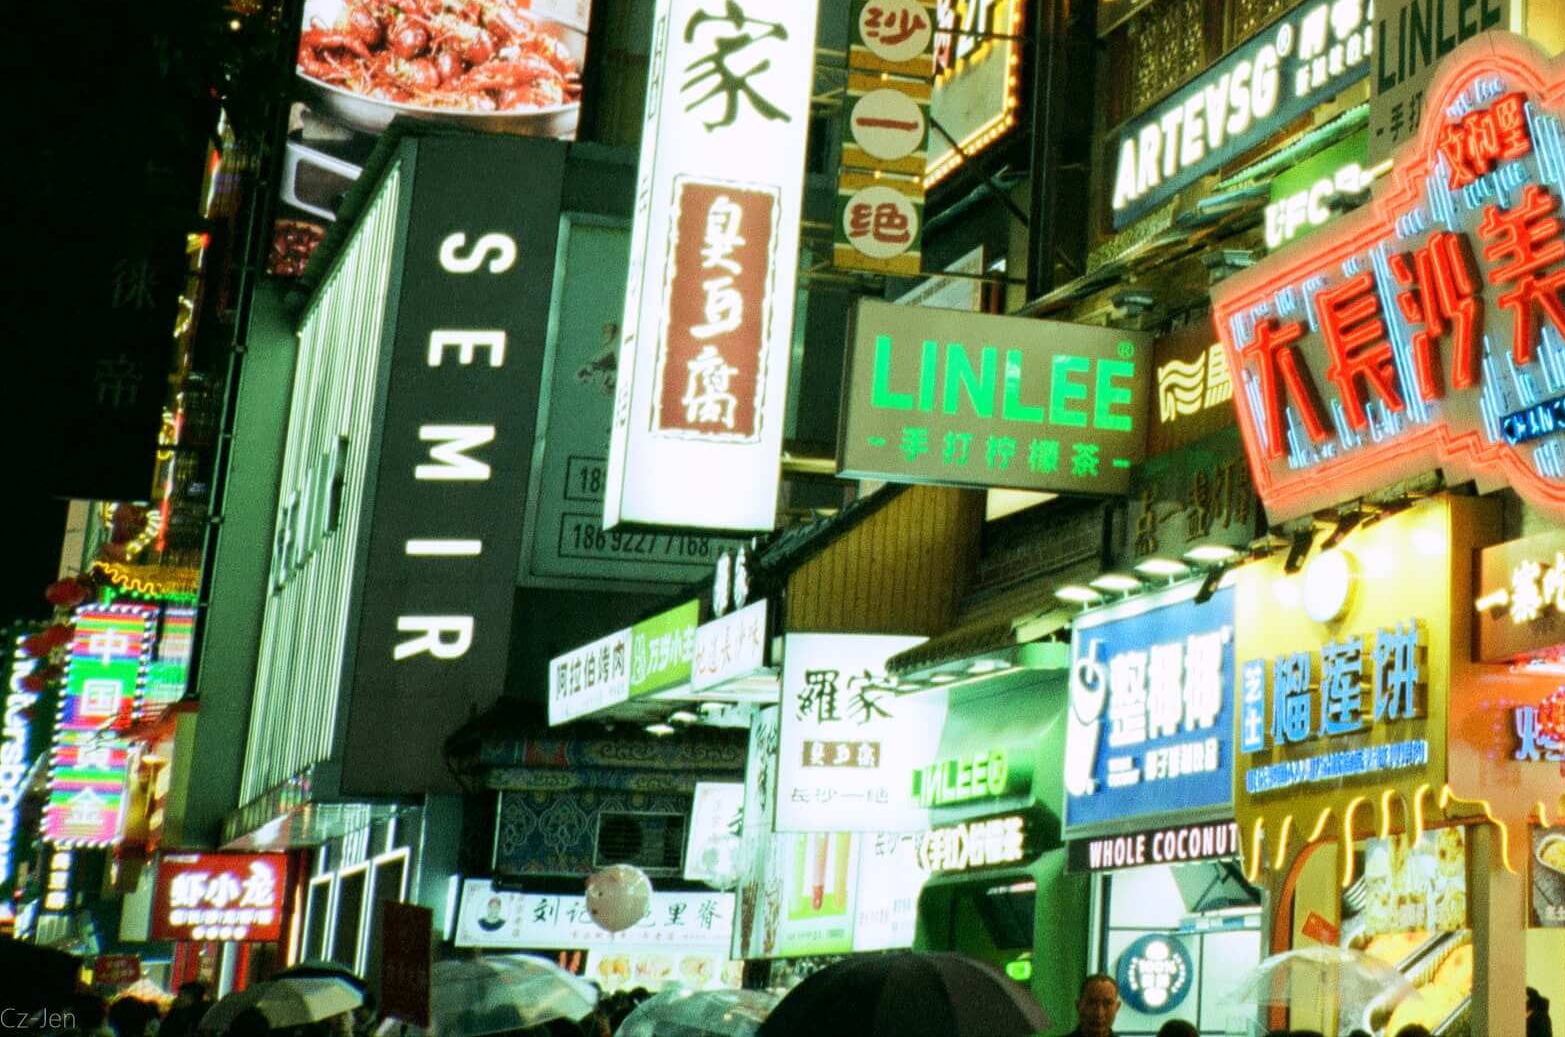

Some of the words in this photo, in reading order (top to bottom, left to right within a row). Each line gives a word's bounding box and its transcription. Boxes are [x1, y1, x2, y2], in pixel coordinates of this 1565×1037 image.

[1437, 91, 1534, 191] 文和里
[682, 195, 745, 430] 臭豆腐
[870, 335, 1135, 433] LINLEE
[394, 232, 516, 661] SEMIR
[556, 639, 626, 701] 阿拉伯烤肉
[796, 668, 895, 725] 羅家
[1272, 622, 1421, 741] 榴莲饼
[1089, 834, 1147, 868] WHOLE
[1152, 822, 1238, 860] COCONUT
